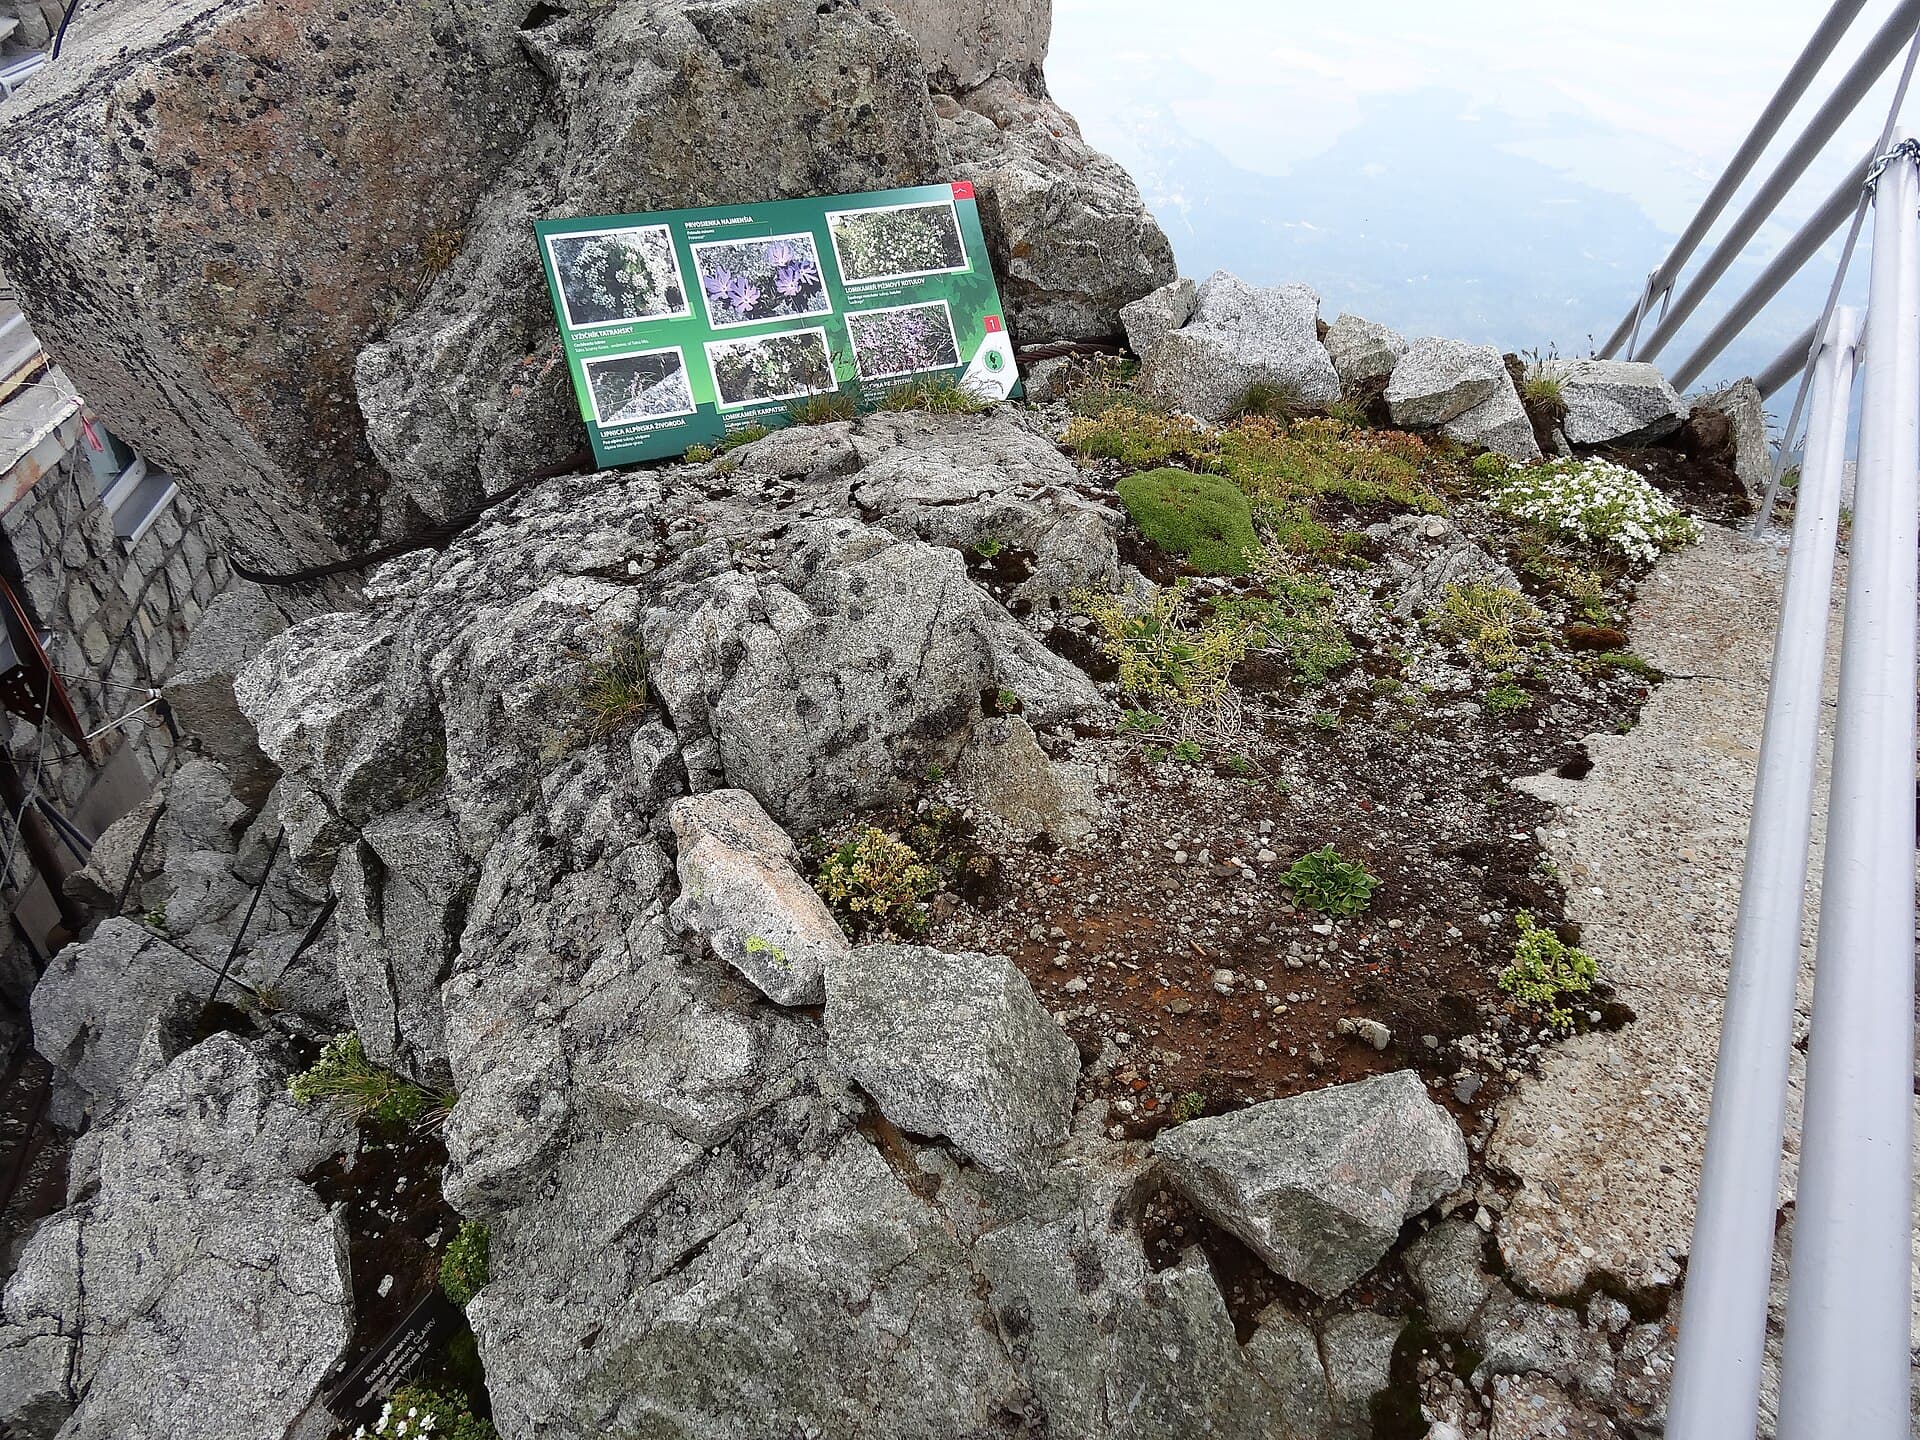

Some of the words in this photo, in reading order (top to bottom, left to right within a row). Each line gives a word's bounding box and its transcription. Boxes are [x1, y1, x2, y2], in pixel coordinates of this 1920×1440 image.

[684, 219, 721, 229] PRVOSIENKA
[989, 319, 996, 330] 1
[600, 429, 625, 438] LIPNICA
[625, 424, 655, 434] ALPÍNSKA
[655, 418, 687, 430] ŽIVORODÁ
